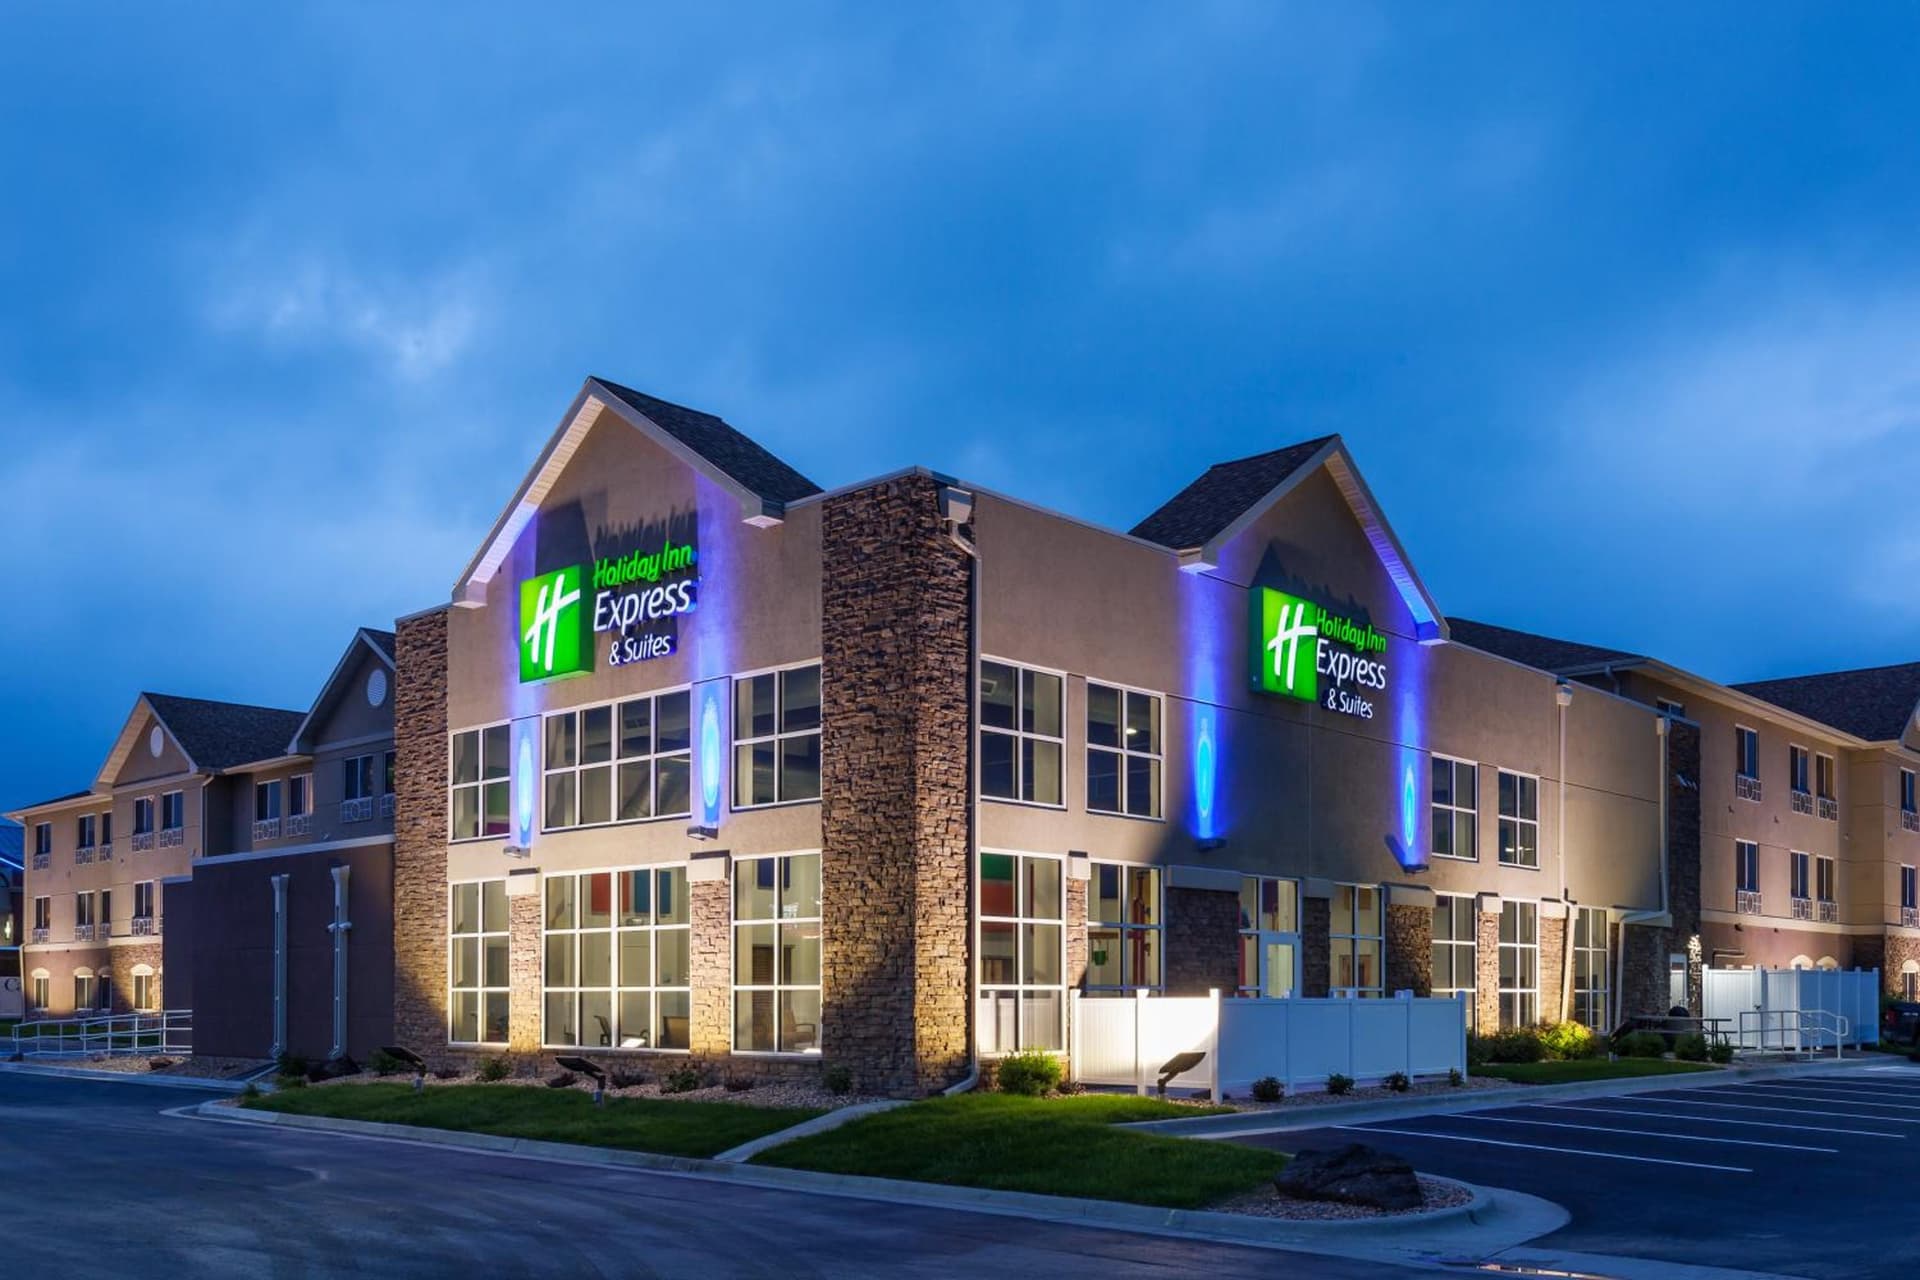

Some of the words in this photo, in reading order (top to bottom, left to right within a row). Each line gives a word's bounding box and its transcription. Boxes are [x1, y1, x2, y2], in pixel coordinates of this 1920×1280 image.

[592, 550, 660, 589] Holiday
[662, 540, 692, 571] Inn
[593, 579, 692, 636] Express
[1316, 607, 1365, 652] Holiday
[1367, 625, 1387, 653] Inn
[608, 640, 621, 666] &
[623, 632, 672, 664] Suites
[1316, 638, 1387, 690] Express
[1327, 687, 1337, 711] &
[1339, 691, 1374, 719] Suites
